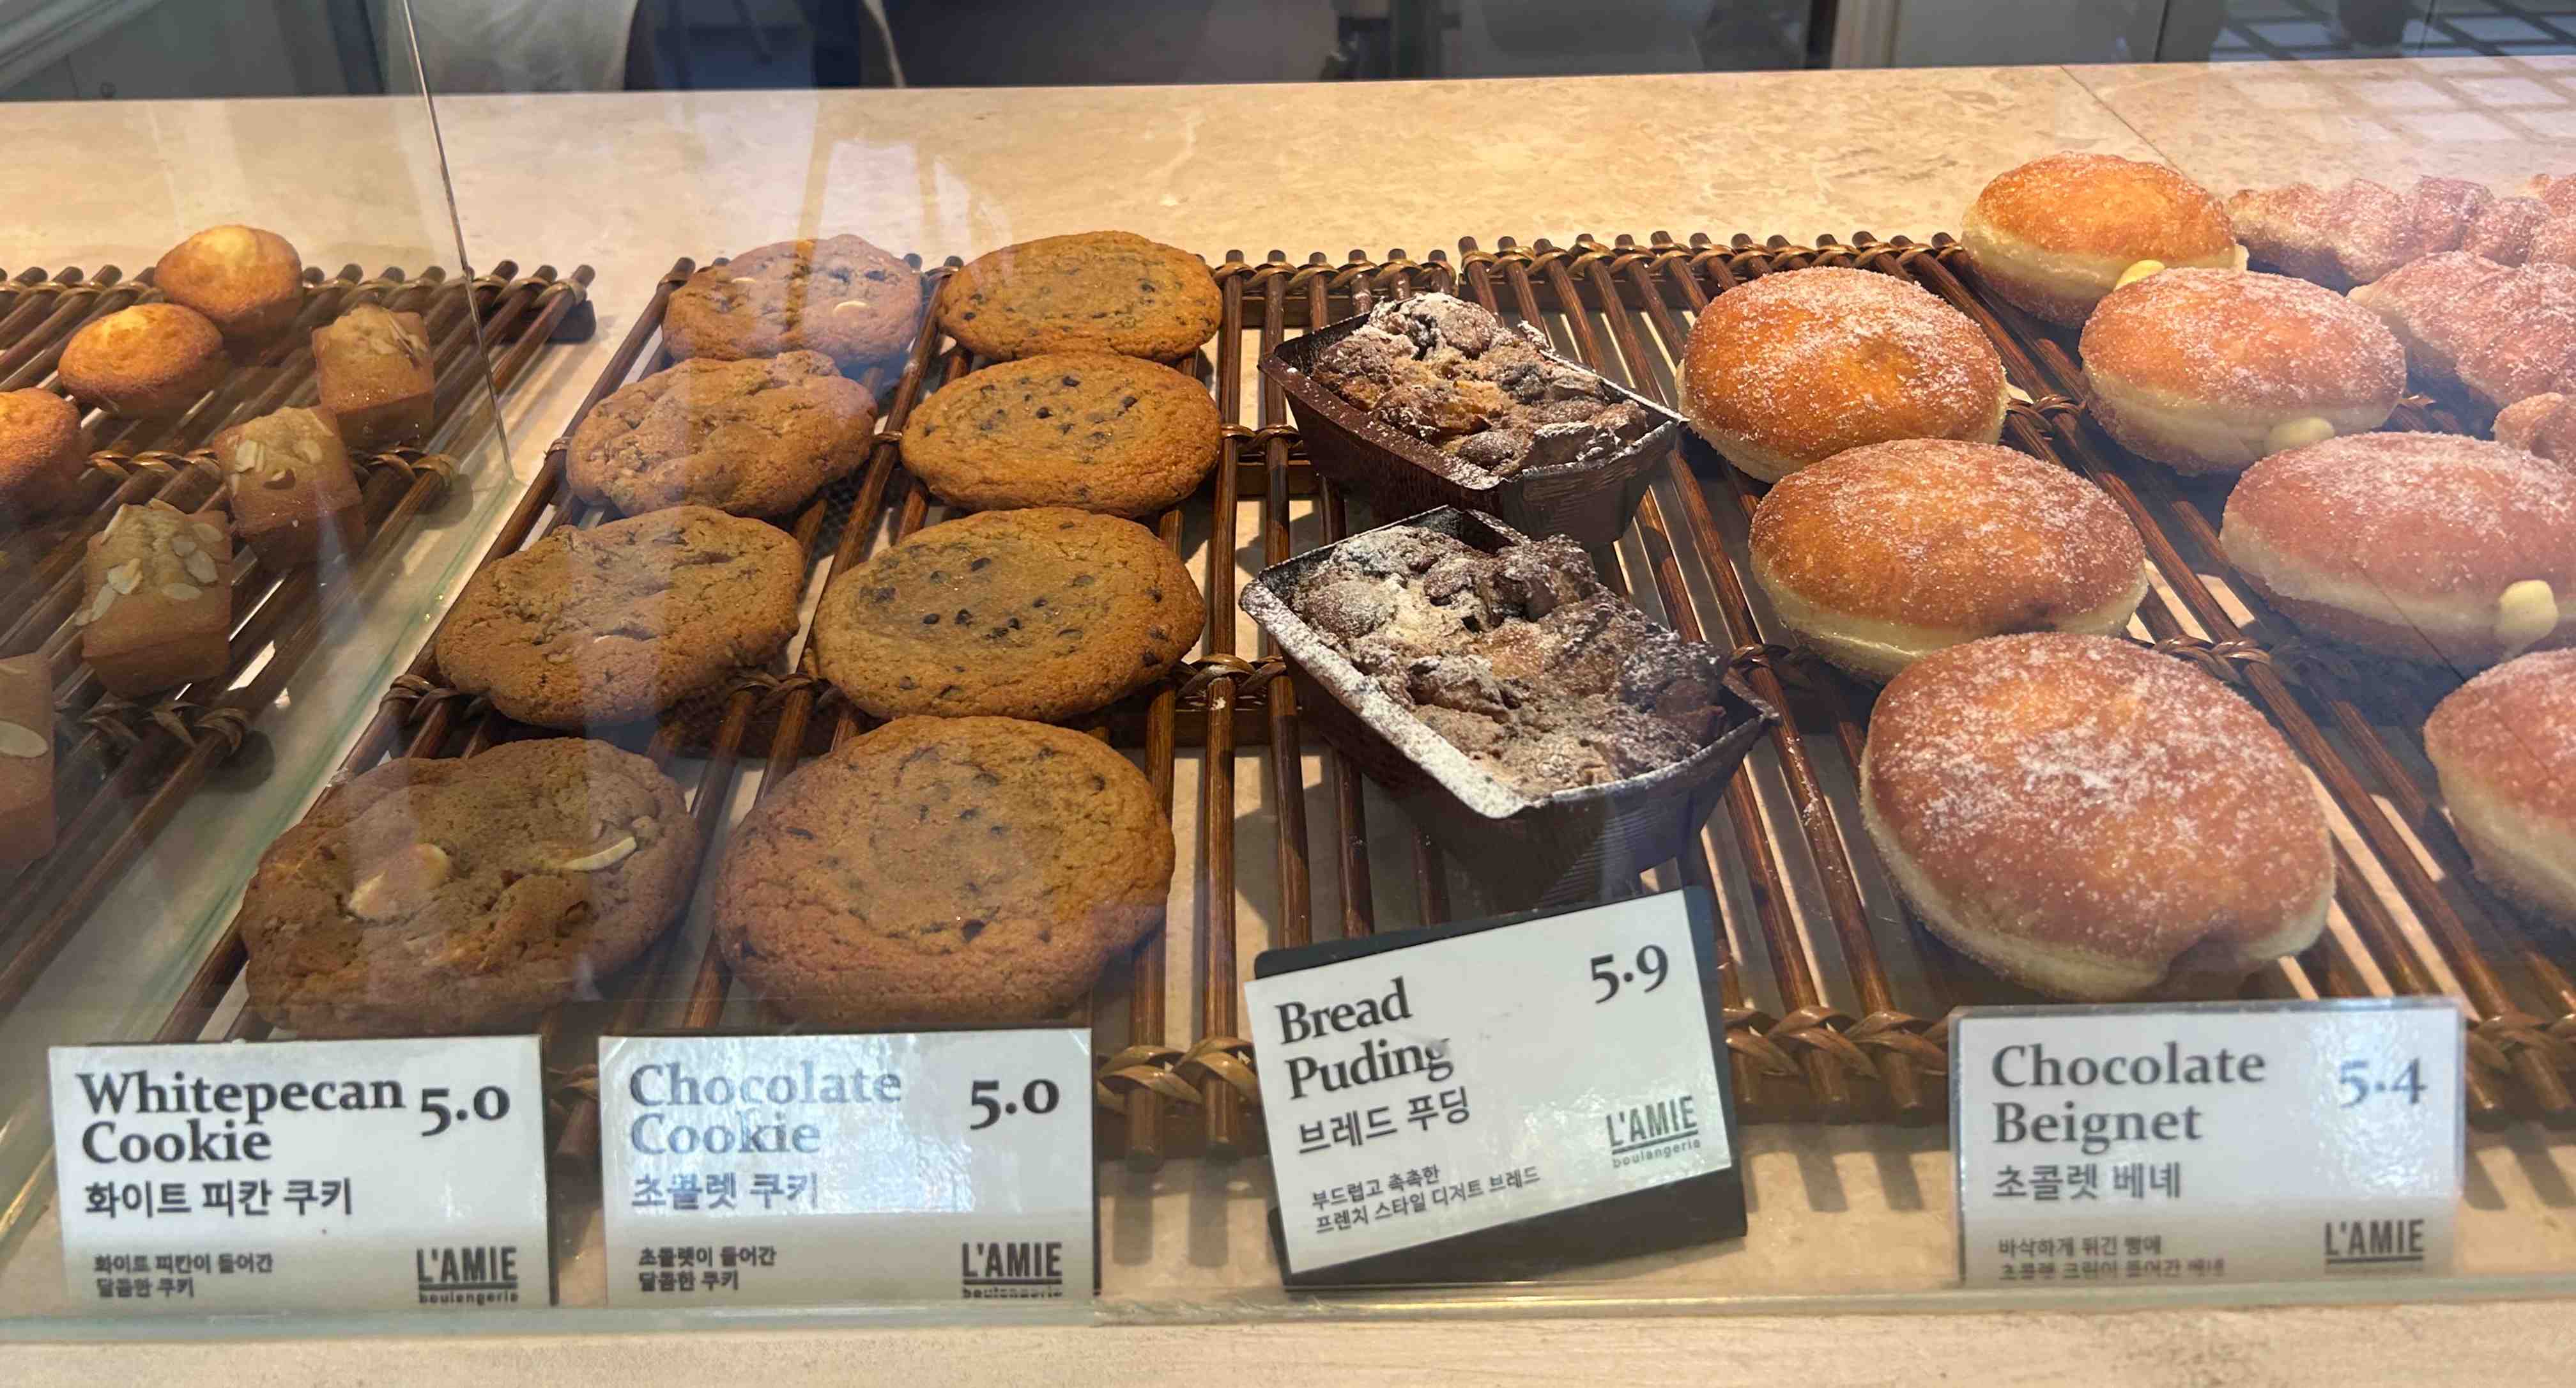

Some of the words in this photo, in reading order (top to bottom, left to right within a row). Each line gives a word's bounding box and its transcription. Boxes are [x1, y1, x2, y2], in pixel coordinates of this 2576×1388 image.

[1590, 944, 1669, 1004] 5.9
[1275, 976, 1411, 1045] Bread
[629, 1061, 901, 1106] Chocolate
[1285, 1038, 1455, 1100] Puding
[1991, 1042, 2266, 1087] Chocolate
[2340, 1058, 2427, 1108] 5.4
[77, 1070, 406, 1124] Whitepecan
[420, 1084, 510, 1136] 5.0
[970, 1079, 1059, 1130] 5.0
[82, 1120, 271, 1163] Cookie
[631, 1108, 820, 1155] Cookie
[1299, 1105, 1398, 1155] 브레드
[1408, 1086, 1470, 1134] 푸딩
[1606, 1095, 1697, 1146] L'AMIE
[1993, 1100, 2203, 1154] Beignet
[85, 1180, 192, 1219] 화이트
[203, 1178, 272, 1217] 피칸
[283, 1178, 351, 1215] 쿠키
[632, 1172, 737, 1210] 초콜렛
[749, 1172, 817, 1209] 쿠키
[1312, 1179, 1384, 1210] 부드럽고
[1388, 1164, 1440, 1192] 촉촉한
[1316, 1205, 1369, 1234] 프렌치
[1374, 1191, 1427, 1221] 스타일
[1432, 1179, 1483, 1207] 디저트
[1489, 1166, 1540, 1193] 브레드
[1992, 1164, 2098, 1201] 초콜렛
[639, 1246, 713, 1267] 초콜렛이
[720, 1245, 777, 1267] 들어간
[962, 1242, 1062, 1277] L'AMIE
[2325, 1219, 2424, 1256] L'AMIE
[94, 1253, 151, 1274] 화이트
[417, 1247, 518, 1282] L'AMIE
[701, 1270, 739, 1292] 쿠키
[157, 1277, 194, 1298] 쿠키
